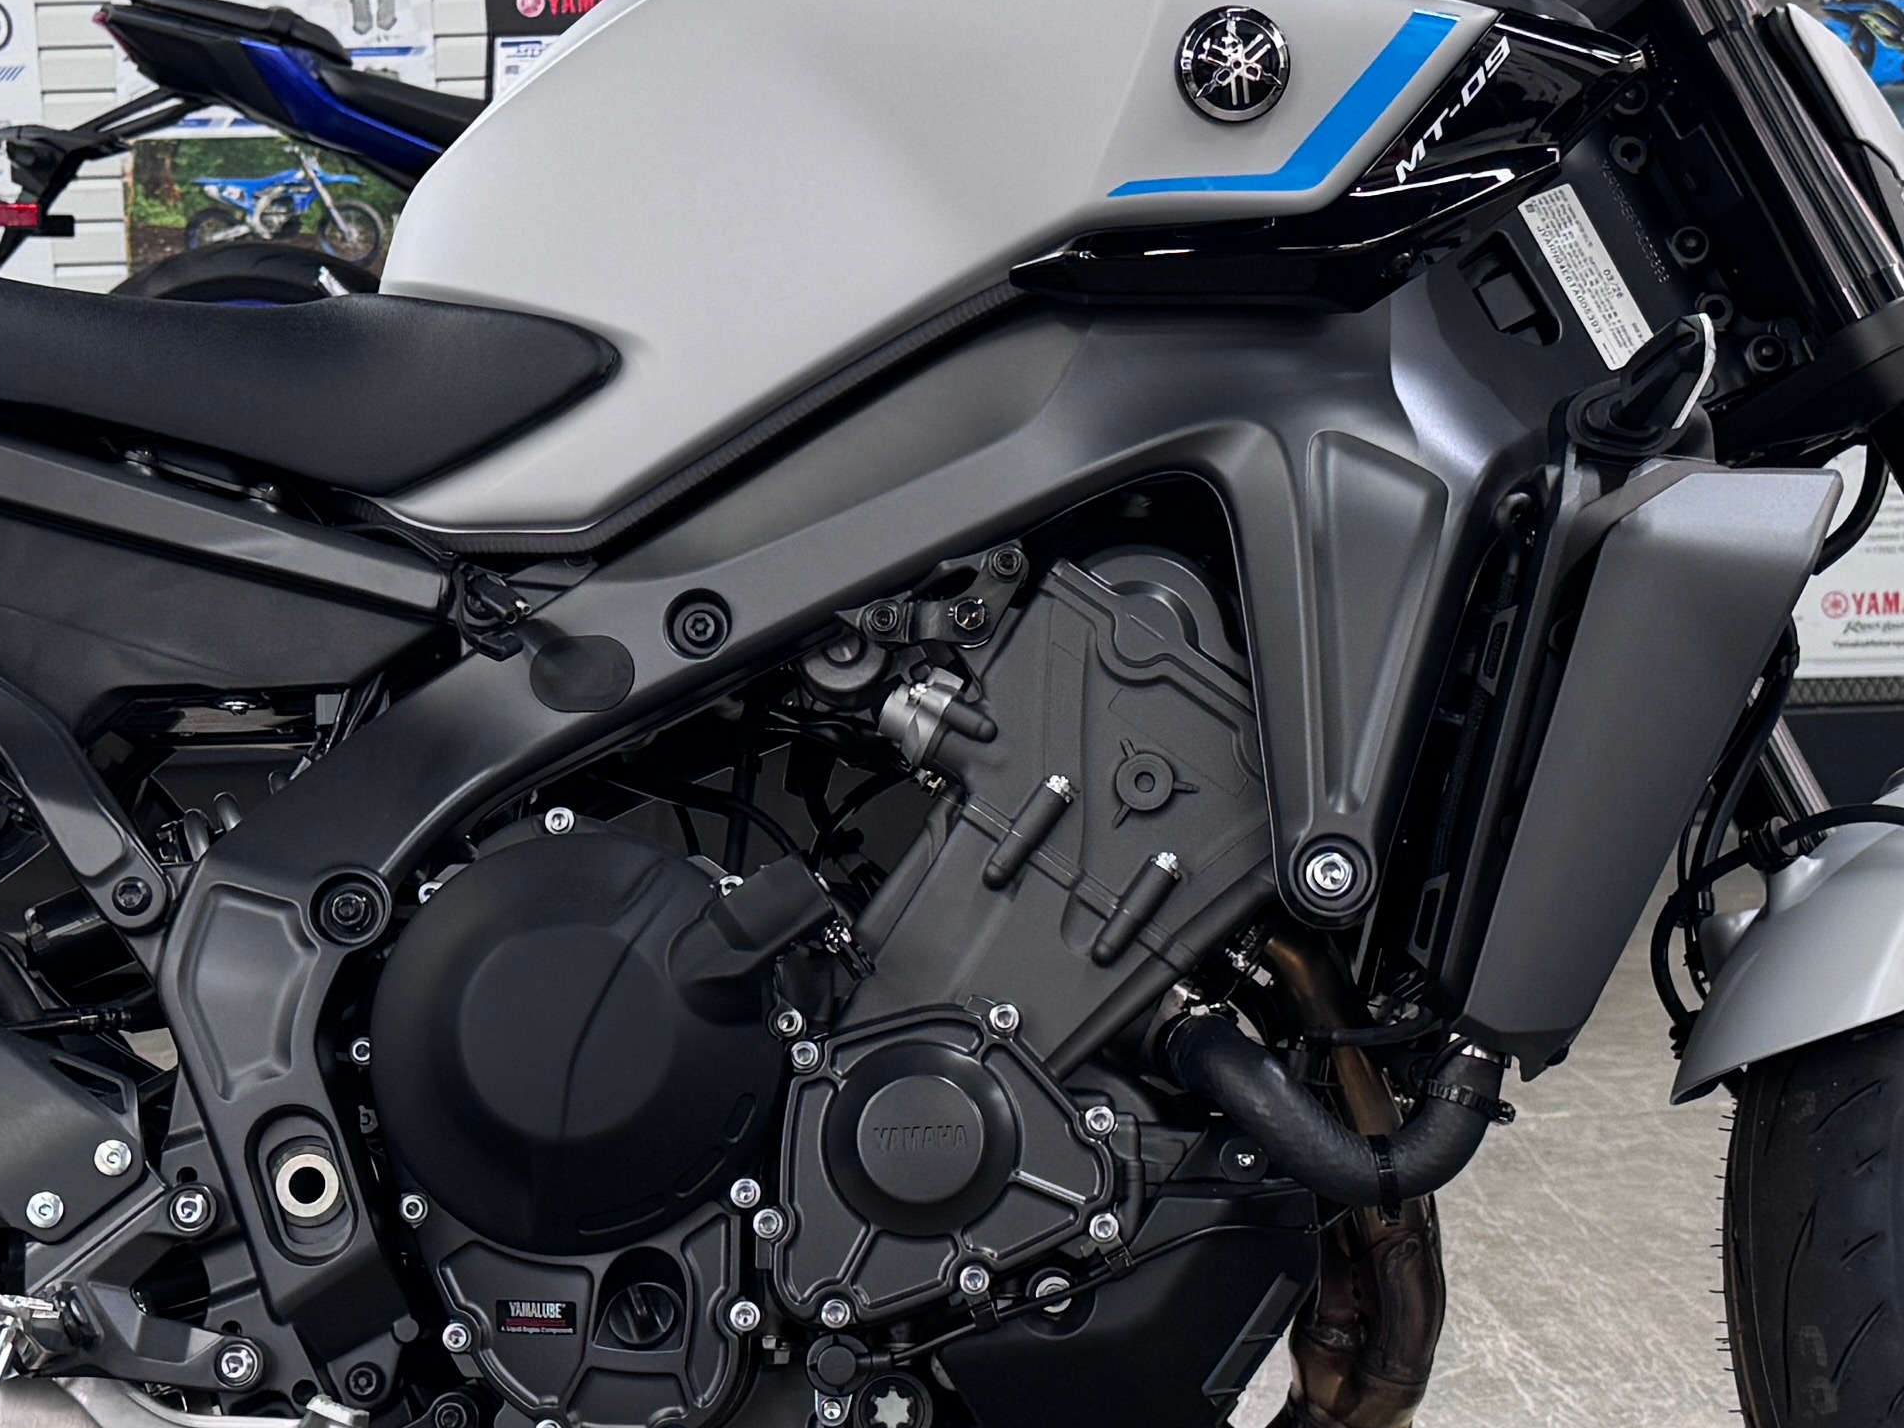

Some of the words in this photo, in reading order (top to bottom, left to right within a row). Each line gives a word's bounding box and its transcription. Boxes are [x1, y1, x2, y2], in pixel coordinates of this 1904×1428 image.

[1395, 35, 1511, 184] MT-09
[873, 1125, 968, 1152] YAMAHA
[508, 1301, 563, 1319] YAMALUBE
